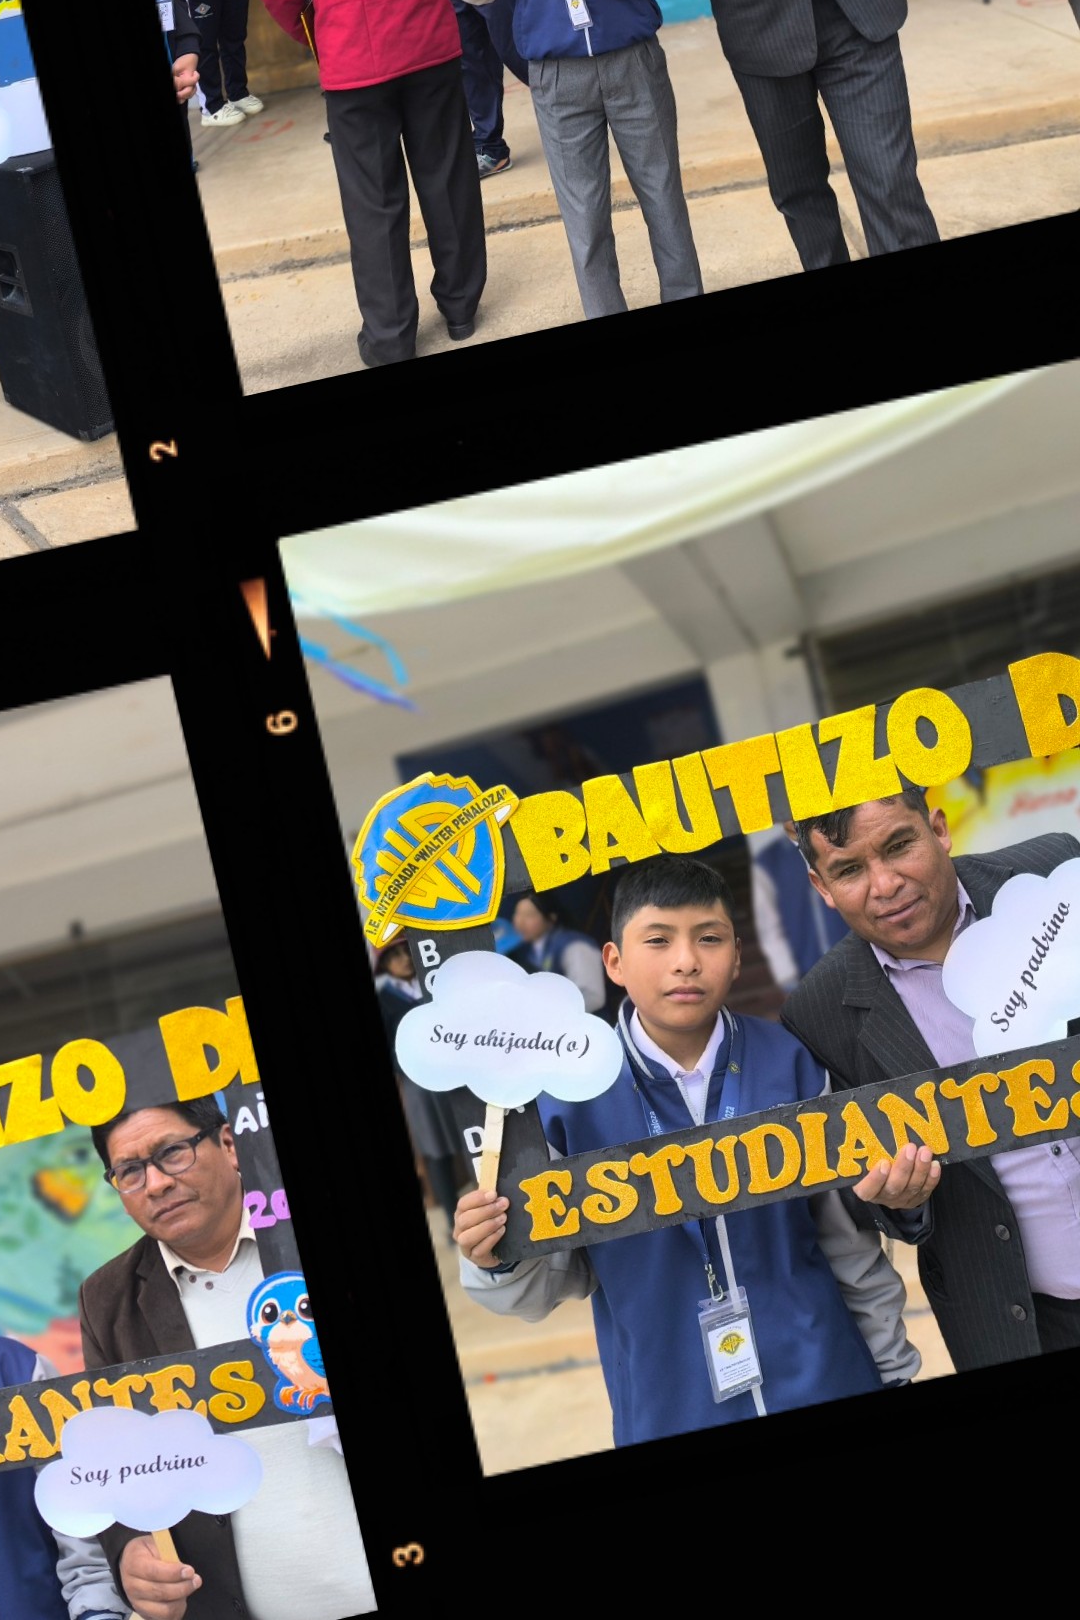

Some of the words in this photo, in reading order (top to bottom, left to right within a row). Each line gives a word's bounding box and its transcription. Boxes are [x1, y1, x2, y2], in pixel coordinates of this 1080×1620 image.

[509, 686, 973, 894] BAUTIZO
[365, 918, 383, 936] I.E.
[375, 862, 420, 917] INTEGRADA
[414, 825, 456, 863] "WALTER
[451, 787, 508, 831] PEÑALOZA"
[990, 987, 1028, 1033] Soy
[1020, 900, 1071, 991] padrino
[429, 1024, 469, 1052] Soy
[473, 1028, 591, 1059] ahijada(o)
[518, 1057, 1080, 1243] ESTUDIANTE
[69, 1464, 111, 1488] Soy
[117, 1450, 210, 1482] padrino
